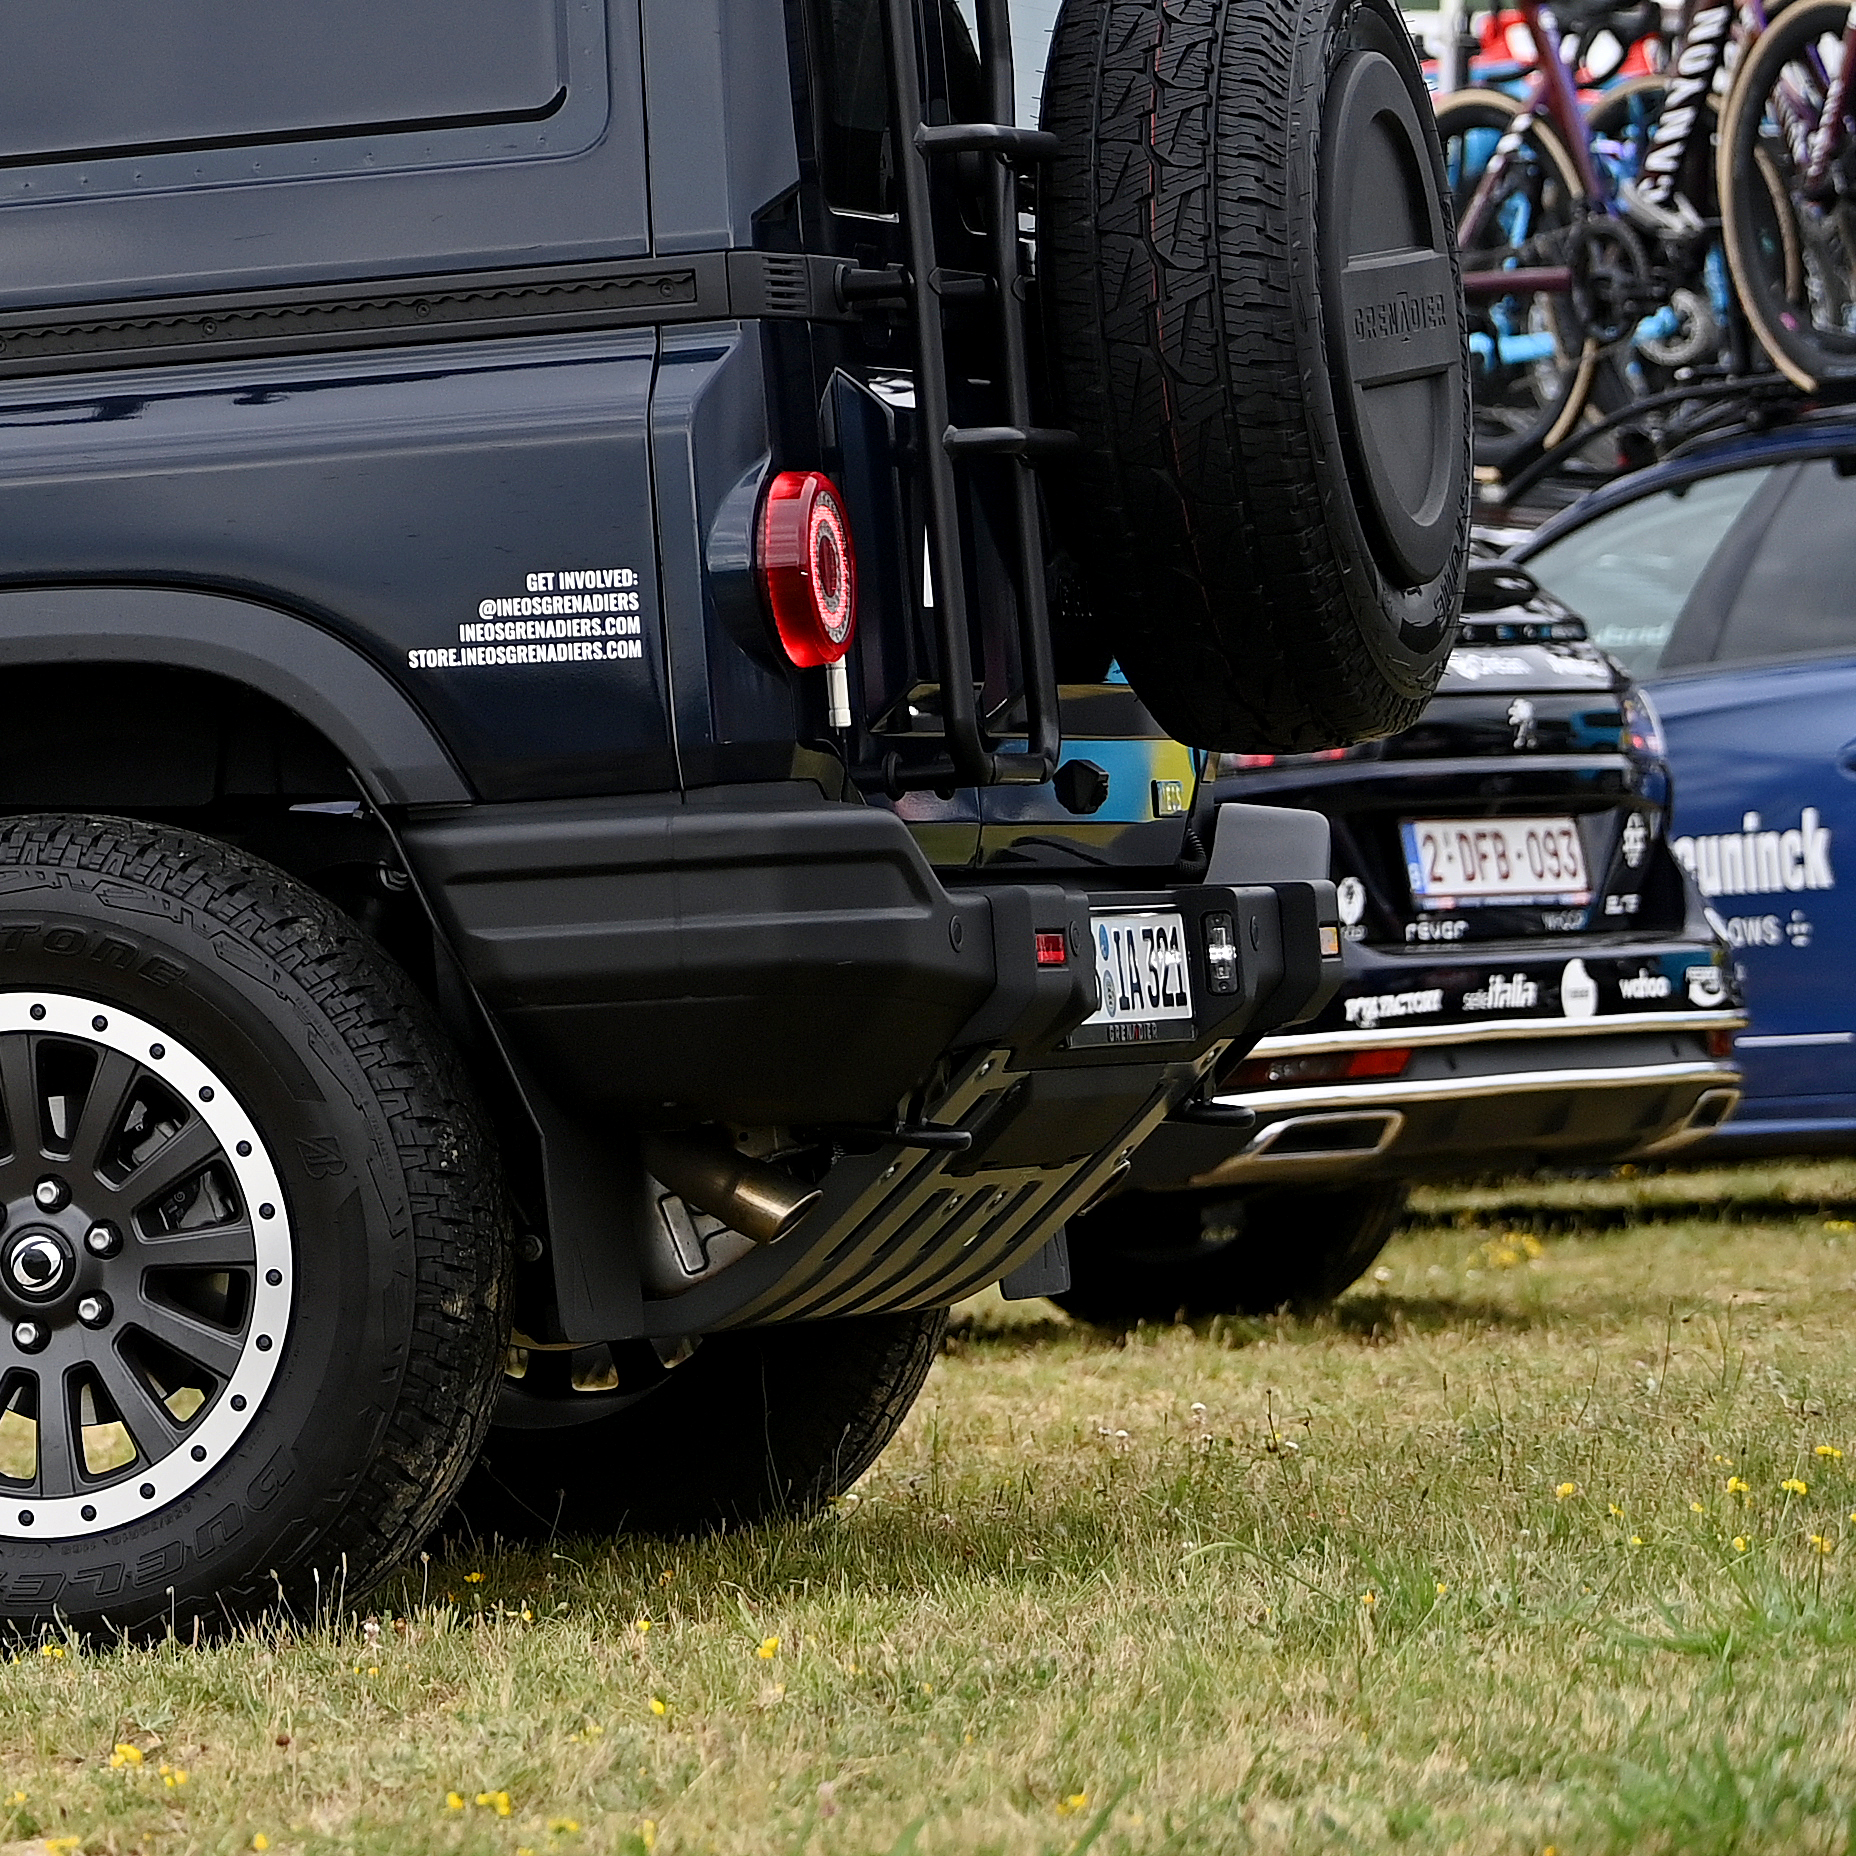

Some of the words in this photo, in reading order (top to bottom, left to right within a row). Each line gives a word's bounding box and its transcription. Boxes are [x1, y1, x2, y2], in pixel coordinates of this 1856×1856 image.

[1636, 5, 1730, 205] CANYON
[1352, 290, 1448, 344] GRENADIER
[525, 571, 556, 593] GET
[557, 567, 640, 591] INVOLVED:
[477, 591, 640, 621] @INEOSGRENADIERS
[458, 615, 642, 644] INEOSGRENADIERS.COM
[407, 638, 643, 670] STORE.INEOSGRENADIERS.COM
[1141, 926, 1188, 1009] 321
[1106, 1021, 1159, 1043] GRENADIER
